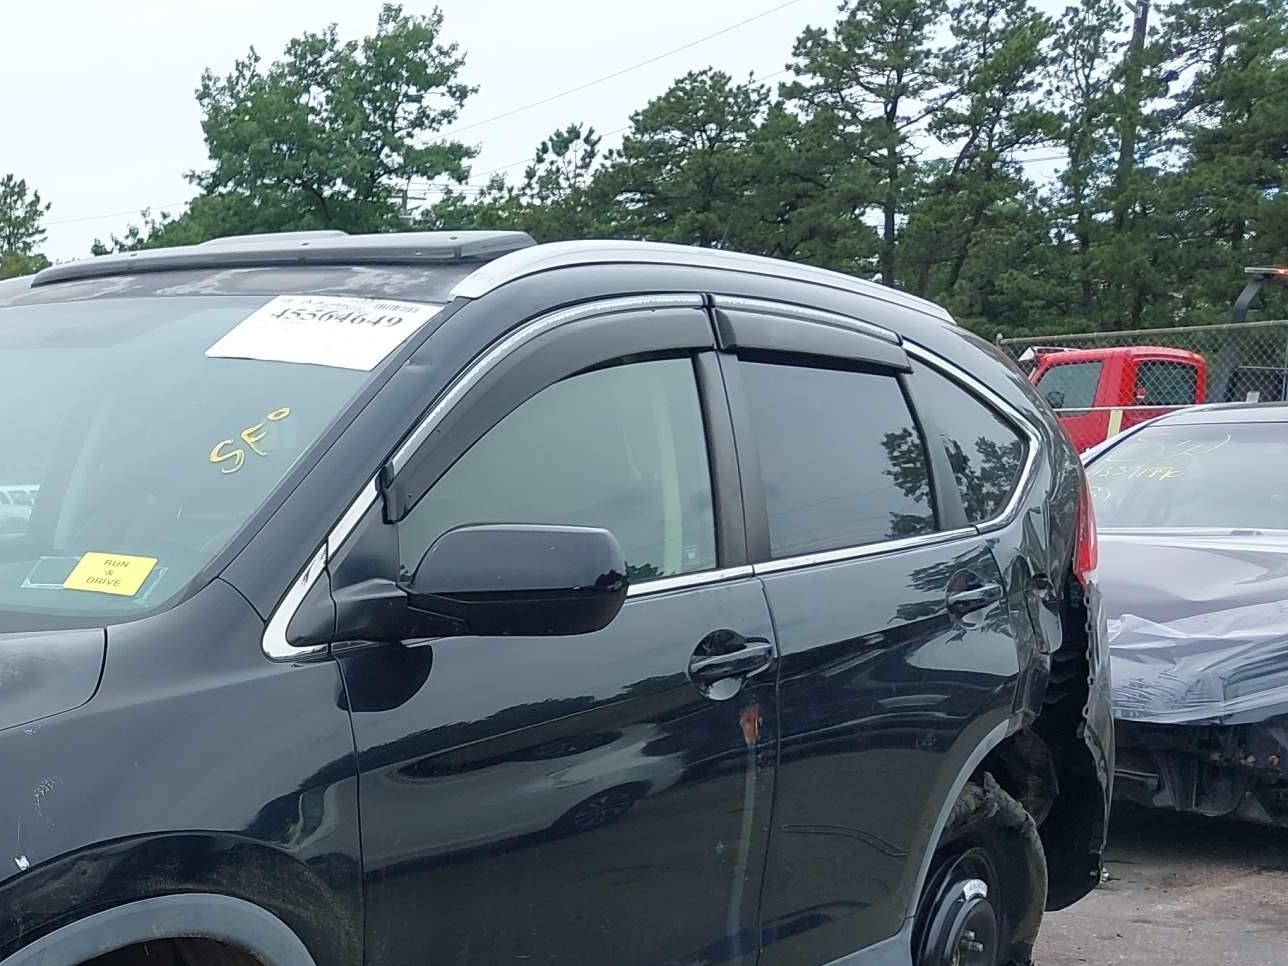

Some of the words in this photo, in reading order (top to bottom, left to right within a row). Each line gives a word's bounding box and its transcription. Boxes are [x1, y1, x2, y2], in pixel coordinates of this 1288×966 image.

[272, 307, 404, 328] 45564649
[103, 559, 130, 568] RUN
[85, 576, 122, 587] DRIVE
